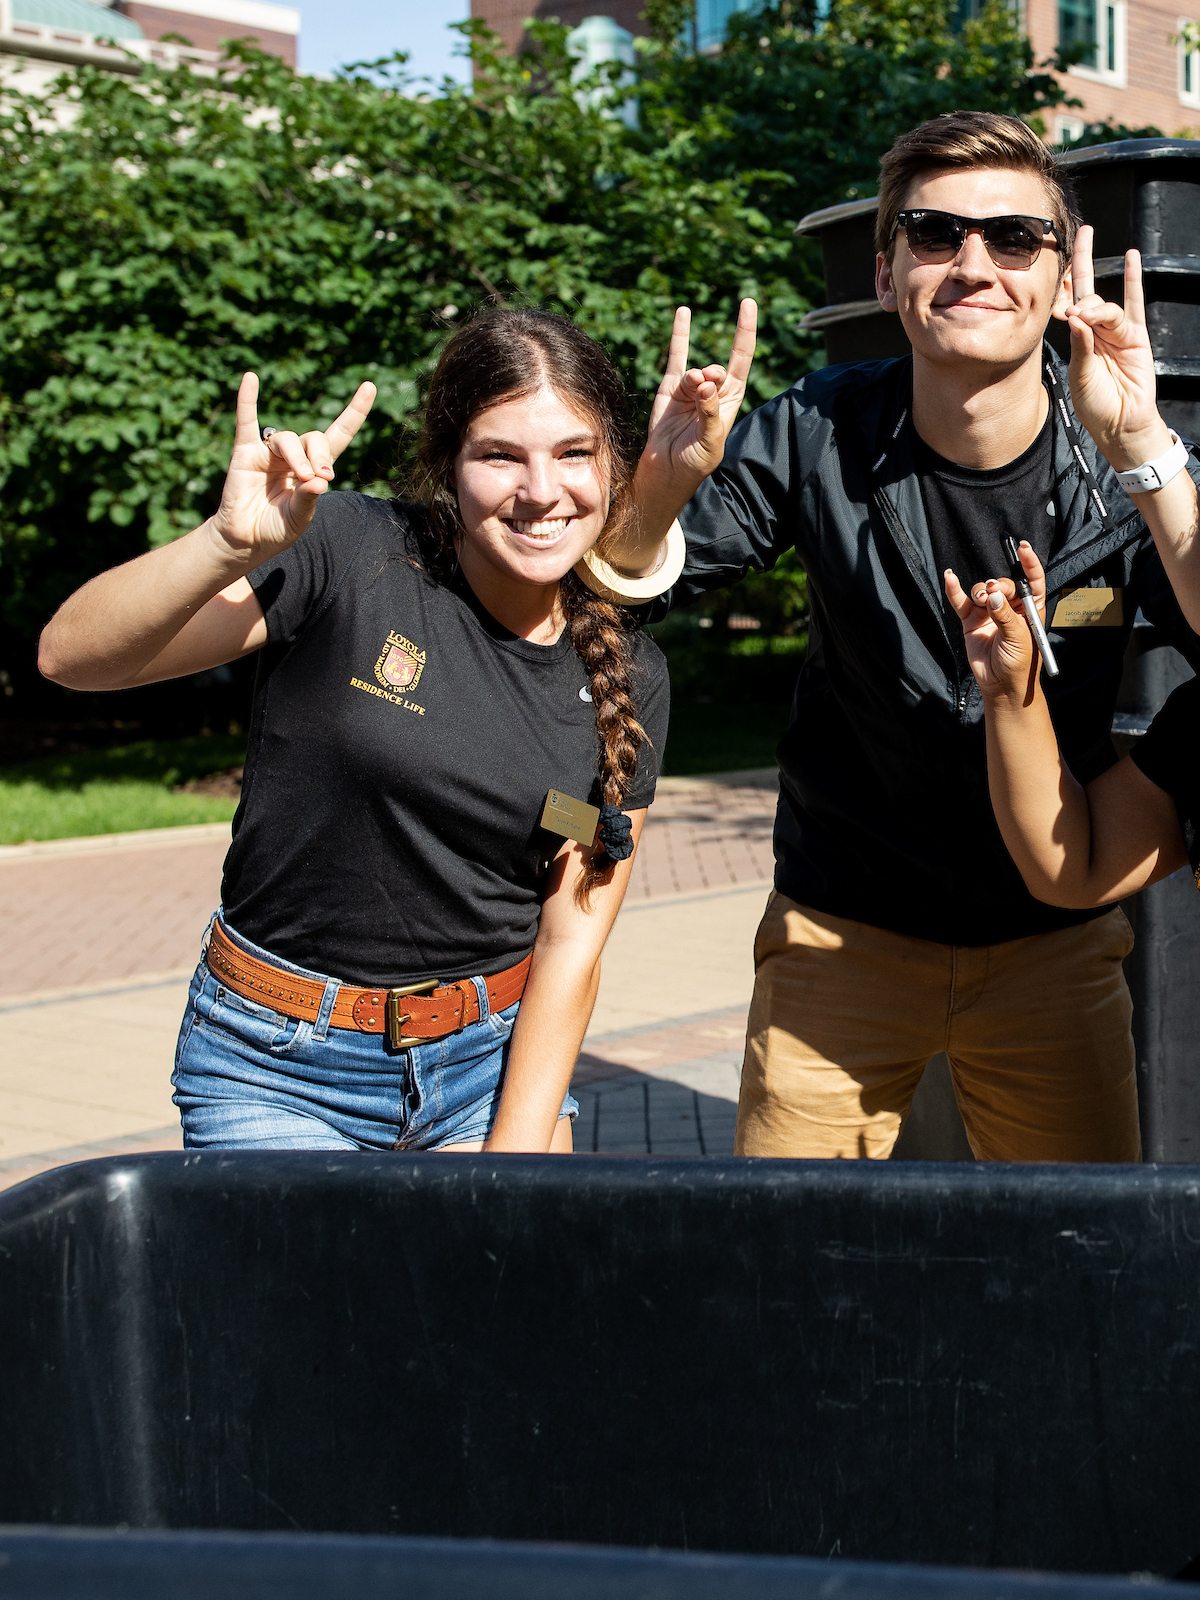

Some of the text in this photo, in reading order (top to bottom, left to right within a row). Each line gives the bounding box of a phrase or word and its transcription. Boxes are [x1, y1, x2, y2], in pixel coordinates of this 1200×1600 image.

[388, 629, 427, 660] LOYOLA
[382, 641, 391, 655] AD
[392, 686, 407, 694] DEI
[349, 676, 426, 716] RESIDENCE LIFE
